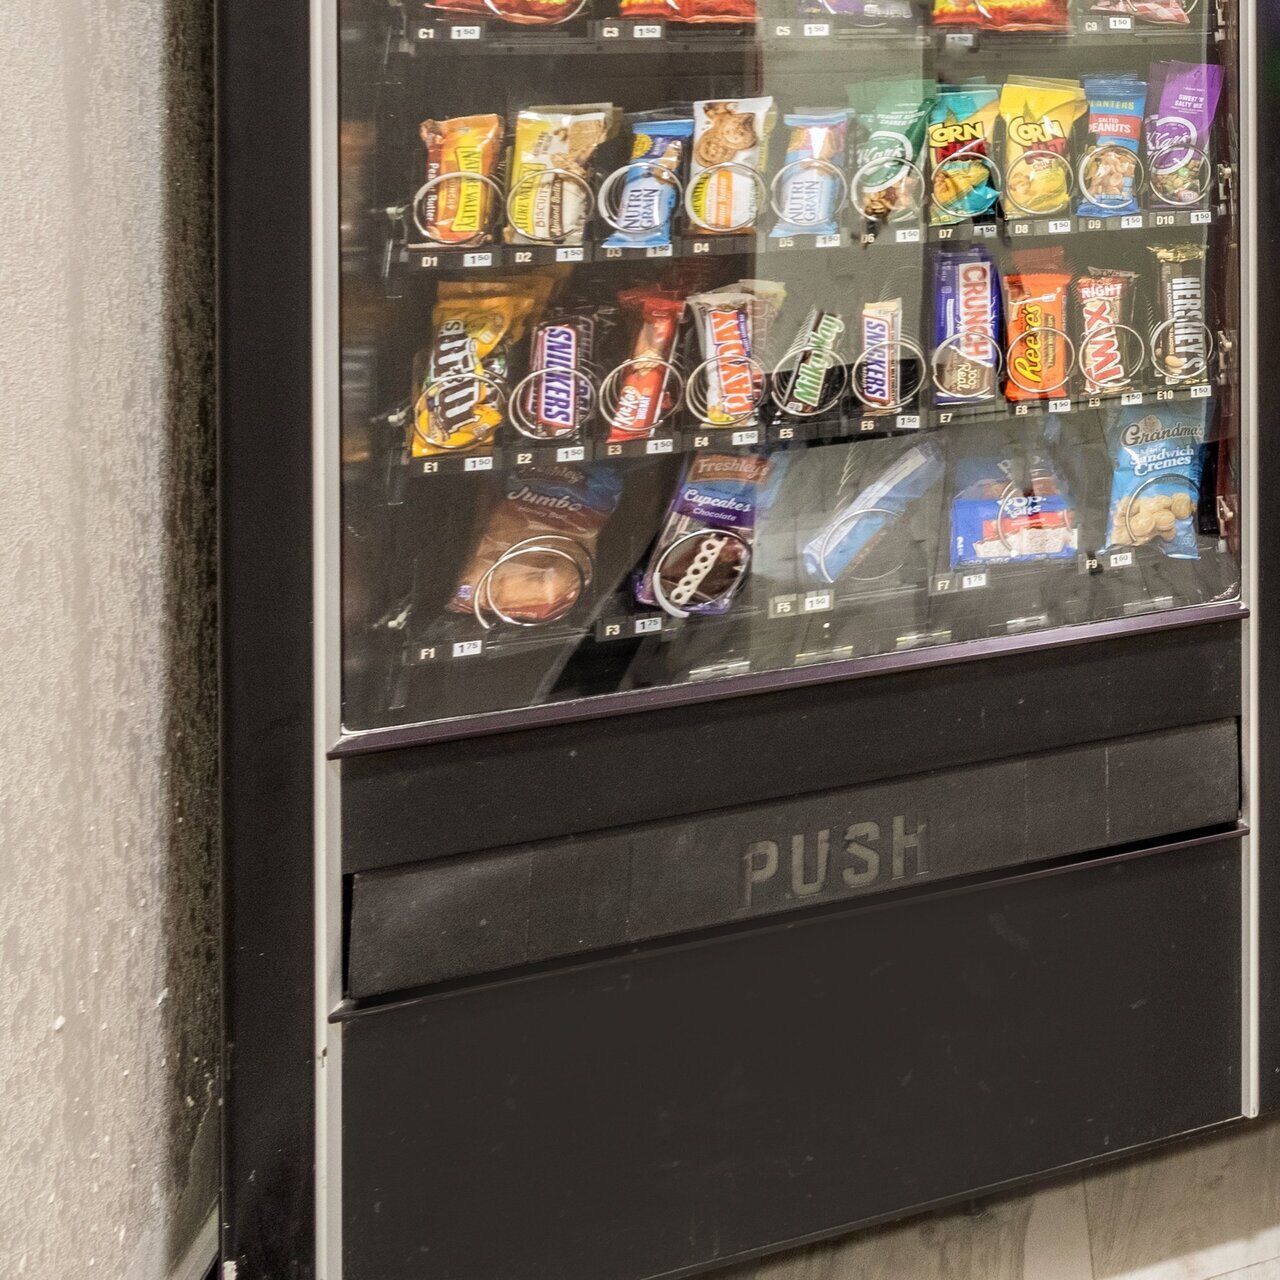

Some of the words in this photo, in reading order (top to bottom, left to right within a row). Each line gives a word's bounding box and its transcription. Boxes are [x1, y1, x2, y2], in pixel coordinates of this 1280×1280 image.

[776, 26, 791, 36] C5
[1085, 21, 1098, 31] C9
[418, 28, 434, 39] C1
[602, 27, 619, 38] C3
[1089, 100, 1135, 111] LANTERS
[929, 121, 984, 147] CORN
[1008, 116, 1066, 147] CORN
[790, 181, 804, 223] NUTRI
[804, 180, 820, 222] GRAIN
[426, 194, 438, 222] Butter
[457, 192, 480, 230] VALLEY
[624, 188, 642, 229] NUTRI
[641, 188, 659, 230] GRAIN
[1088, 219, 1102, 229] D9
[1156, 215, 1175, 225] D10
[939, 229, 953, 238] D7
[1015, 224, 1029, 234] D8
[779, 238, 794, 248] D5
[861, 233, 875, 243] D6
[607, 247, 622, 257] D3
[694, 242, 710, 253] D4
[421, 256, 438, 267] D1
[515, 252, 532, 263] D2
[1081, 283, 1122, 299] RIGHT
[963, 265, 989, 356] CRUNCH
[1172, 277, 1204, 370] HERSHEY'S
[1083, 302, 1124, 393] TWIX
[709, 310, 754, 415] PAYDAY
[866, 320, 887, 398] SNICKERS
[543, 327, 573, 423] SNICKERS
[956, 362, 970, 391] Real
[1157, 390, 1174, 400] E10
[1089, 398, 1101, 407] E9
[1015, 405, 1028, 415] E8
[939, 413, 953, 423] E7
[861, 421, 875, 430] E6
[779, 429, 794, 439] E5
[694, 437, 710, 447] E4
[607, 445, 622, 456] E3
[1129, 445, 1195, 466] Sandwich
[517, 453, 532, 464] E2
[424, 462, 439, 473] E1
[1134, 454, 1193, 476] Cremes
[507, 486, 584, 512] Jumbo
[684, 487, 753, 513] Cupcakes
[693, 507, 737, 522] Chocolate
[1085, 559, 1098, 569] F9
[937, 580, 950, 591] F7
[777, 602, 791, 613] F5
[606, 625, 621, 636] F3
[421, 648, 436, 660] F1
[741, 814, 930, 910] PUSH
